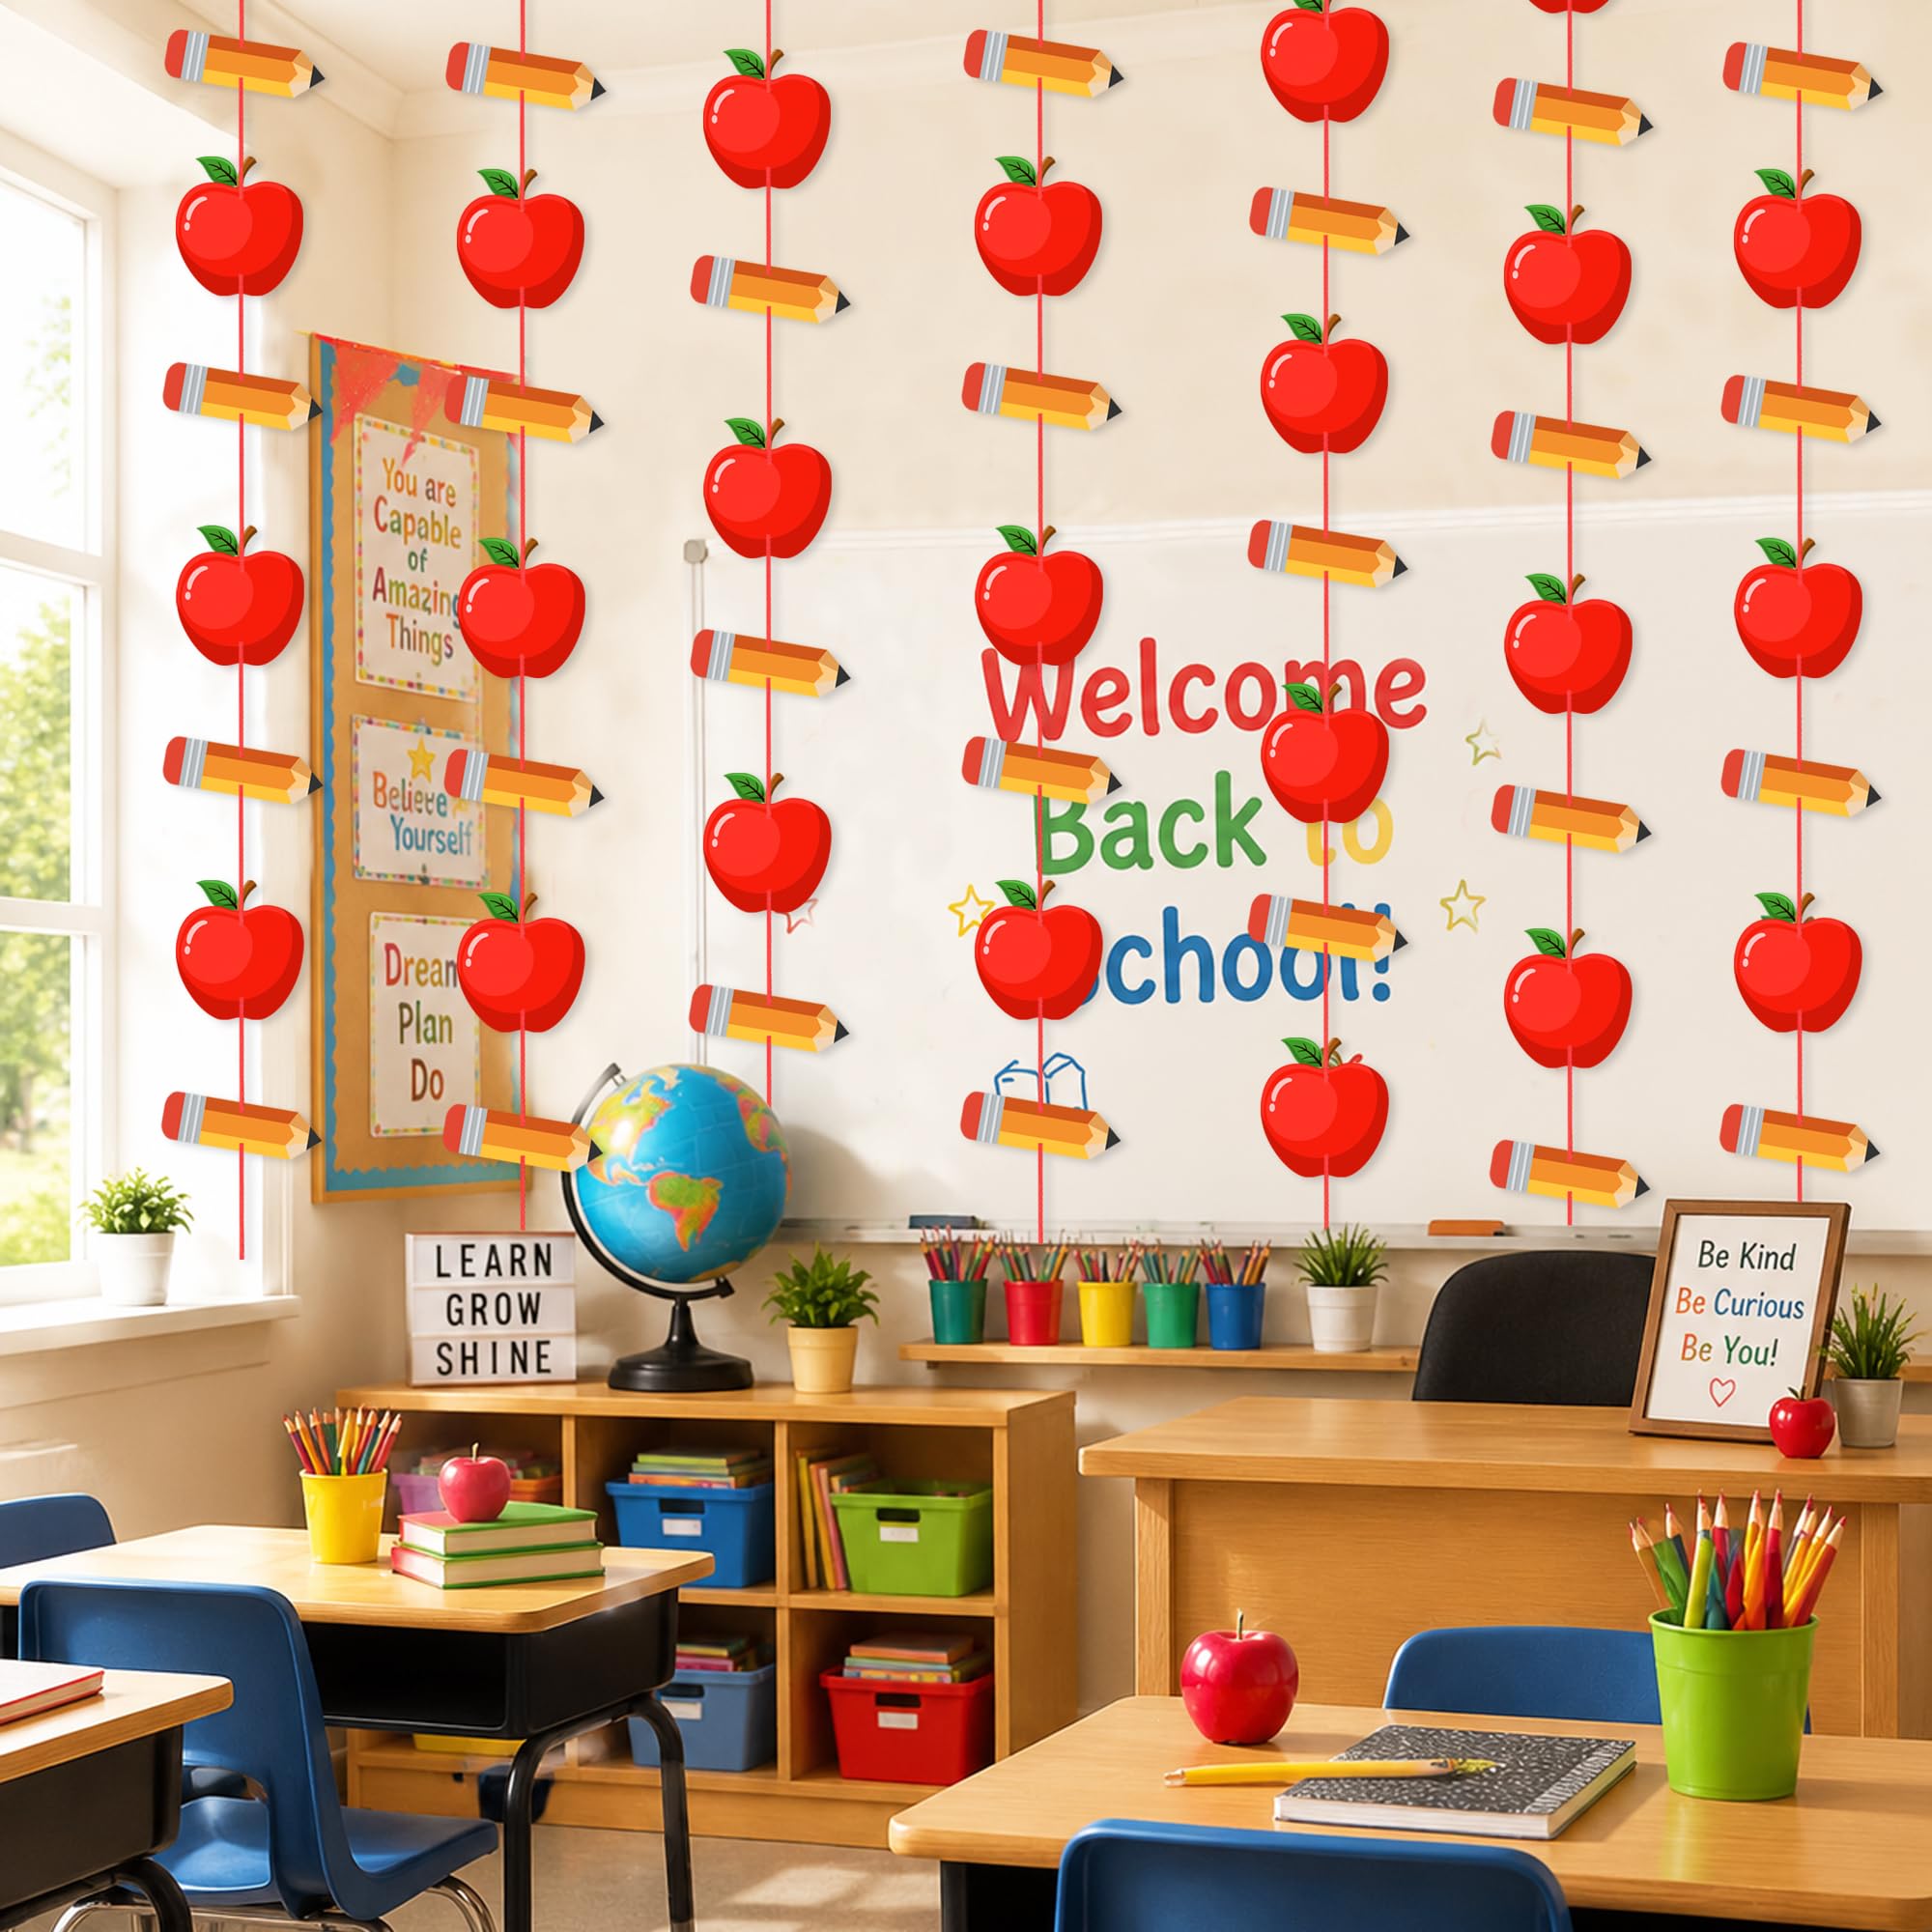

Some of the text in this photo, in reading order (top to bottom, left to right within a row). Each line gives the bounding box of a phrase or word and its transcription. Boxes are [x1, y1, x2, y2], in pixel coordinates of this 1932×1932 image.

[383, 457, 456, 508] You are
[374, 495, 462, 549] Capable
[408, 548, 428, 573] of
[385, 612, 454, 668] Things
[389, 812, 474, 857] Yourself
[1033, 770, 1266, 875] Back
[1079, 902, 1391, 1005] chool!
[398, 1000, 453, 1045] Plan
[411, 1058, 444, 1102] Do
[437, 1242, 552, 1278] LEARN
[1697, 1239, 1797, 1271] Be Kind
[446, 1292, 541, 1326] GROW
[1675, 1287, 1804, 1320] Be Curious
[437, 1340, 552, 1377] SHINE
[1681, 1332, 1778, 1366] Be You!
